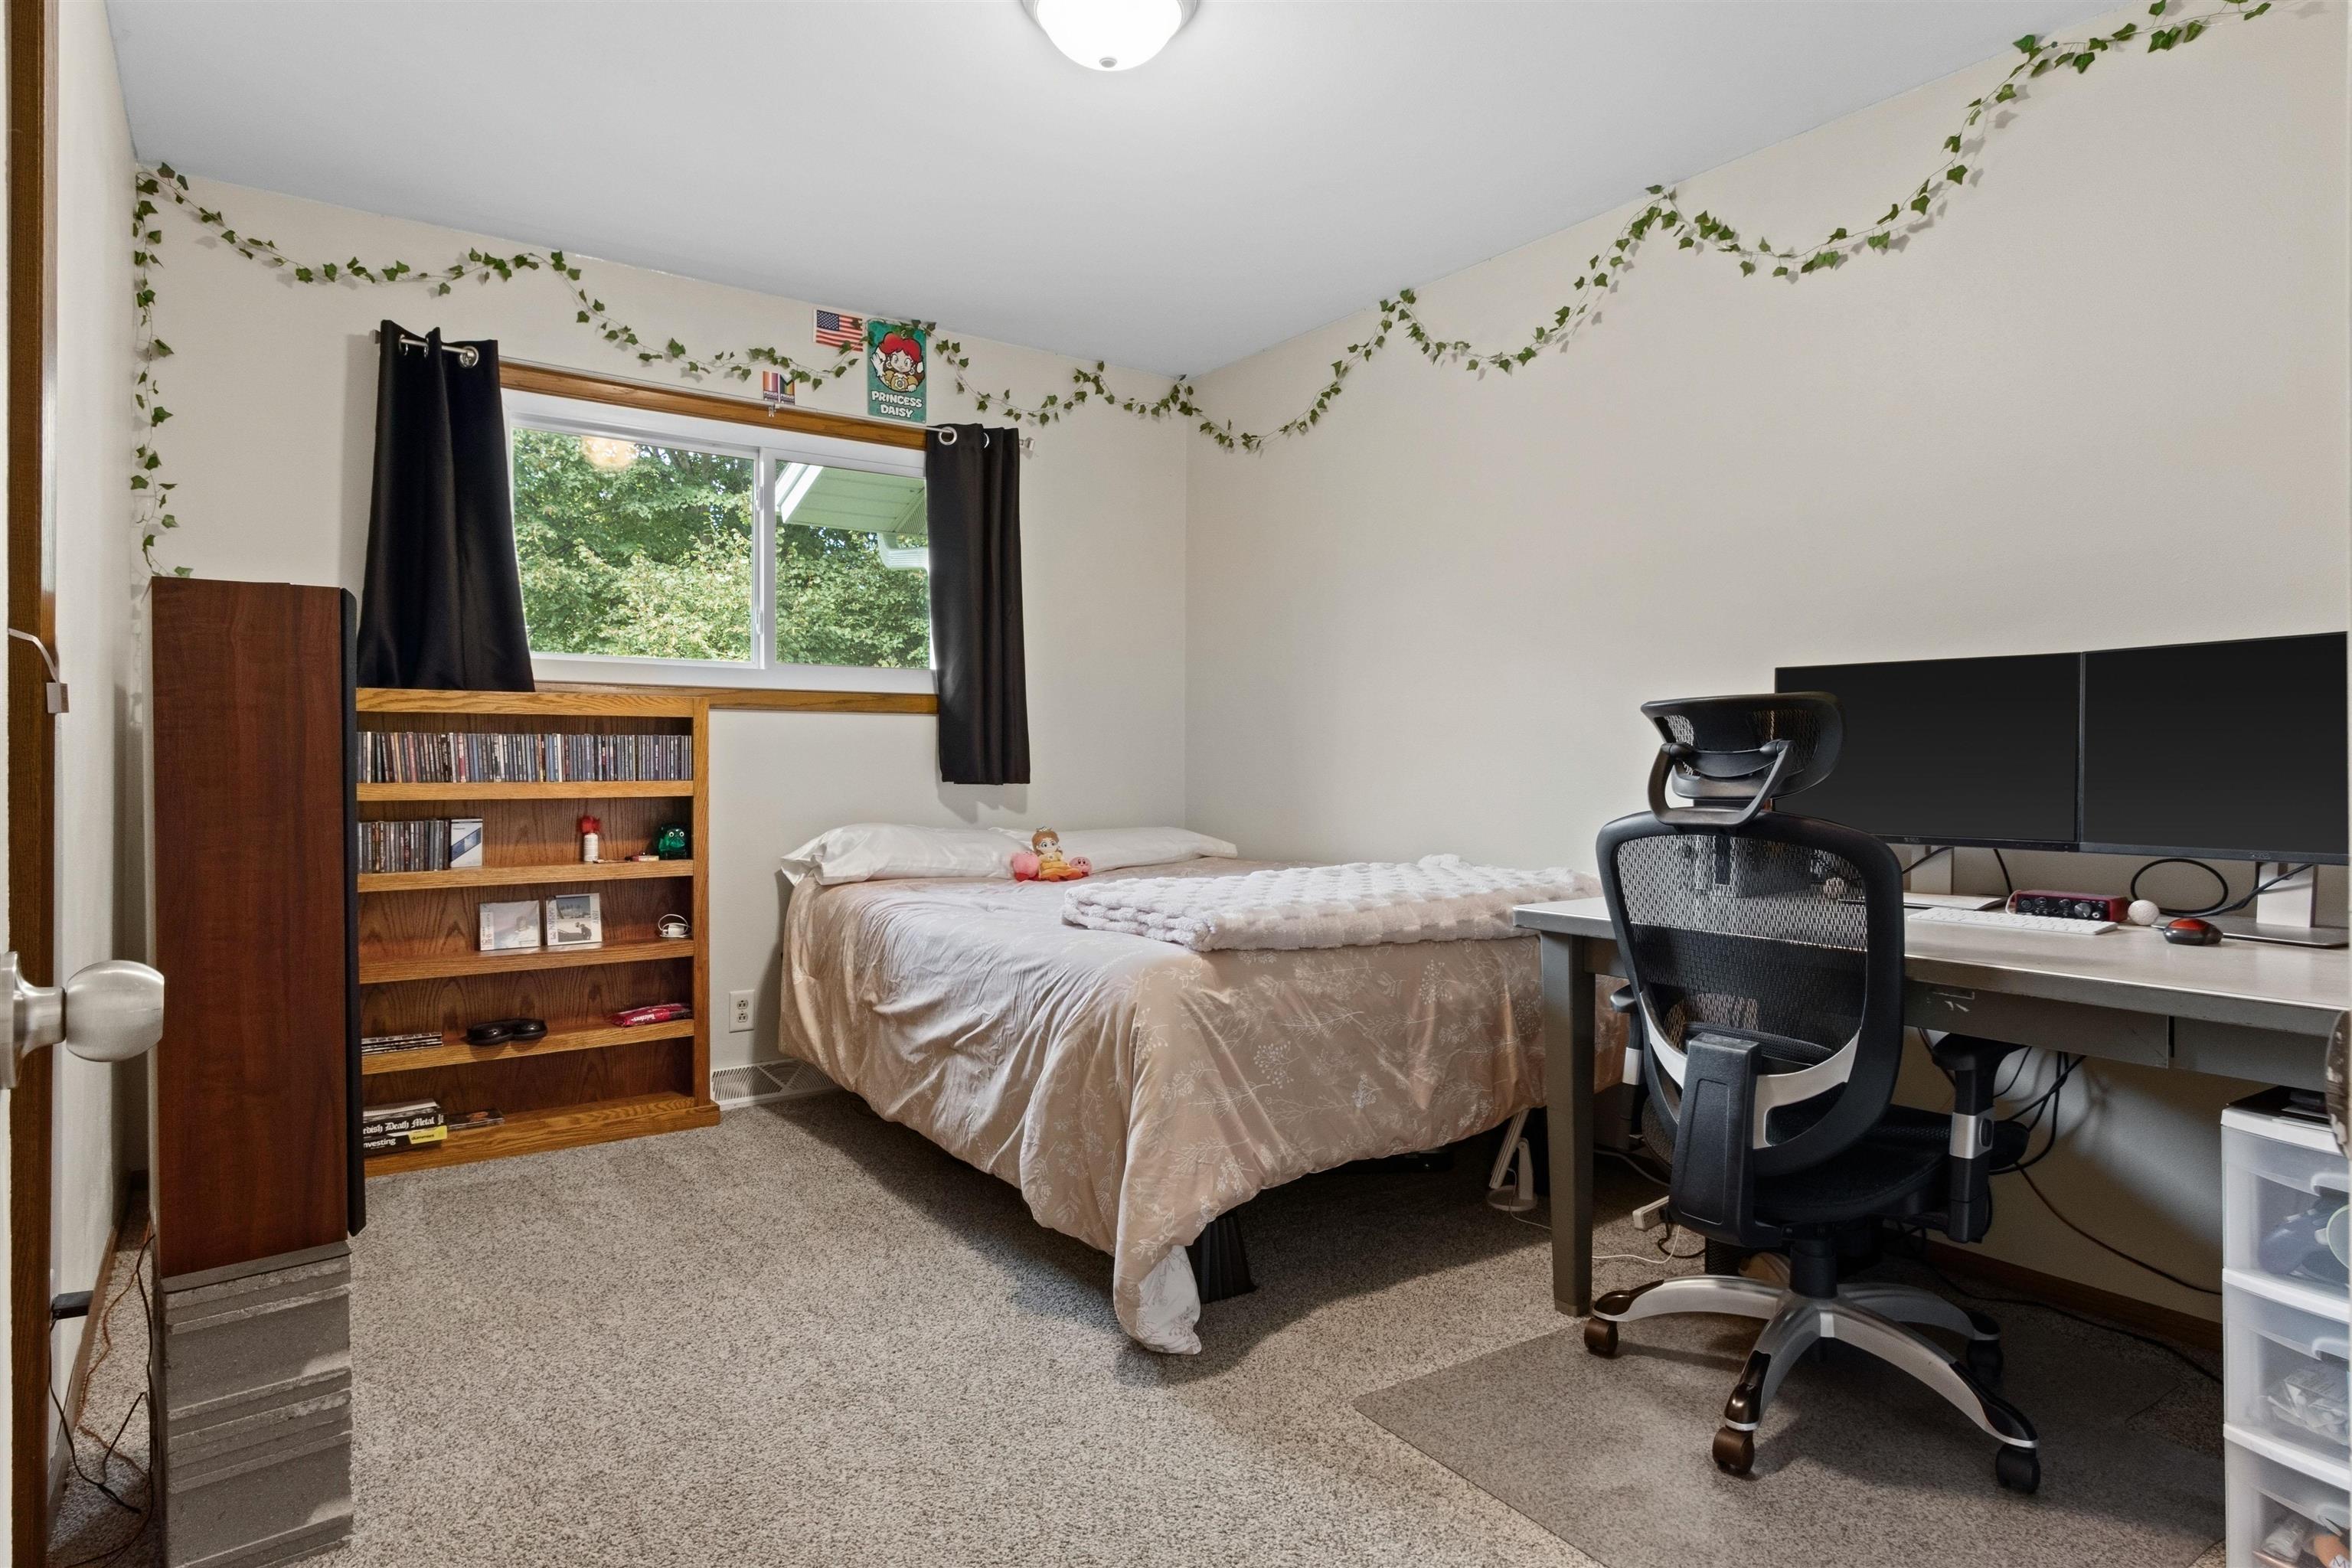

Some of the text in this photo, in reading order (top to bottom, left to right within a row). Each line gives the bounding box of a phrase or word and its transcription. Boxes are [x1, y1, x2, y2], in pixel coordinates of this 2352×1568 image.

[871, 390, 923, 407] PRINCESS
[880, 403, 913, 418] DAISY
[363, 1116, 435, 1135] edish Death Metal
[363, 1138, 397, 1148] nvesting
